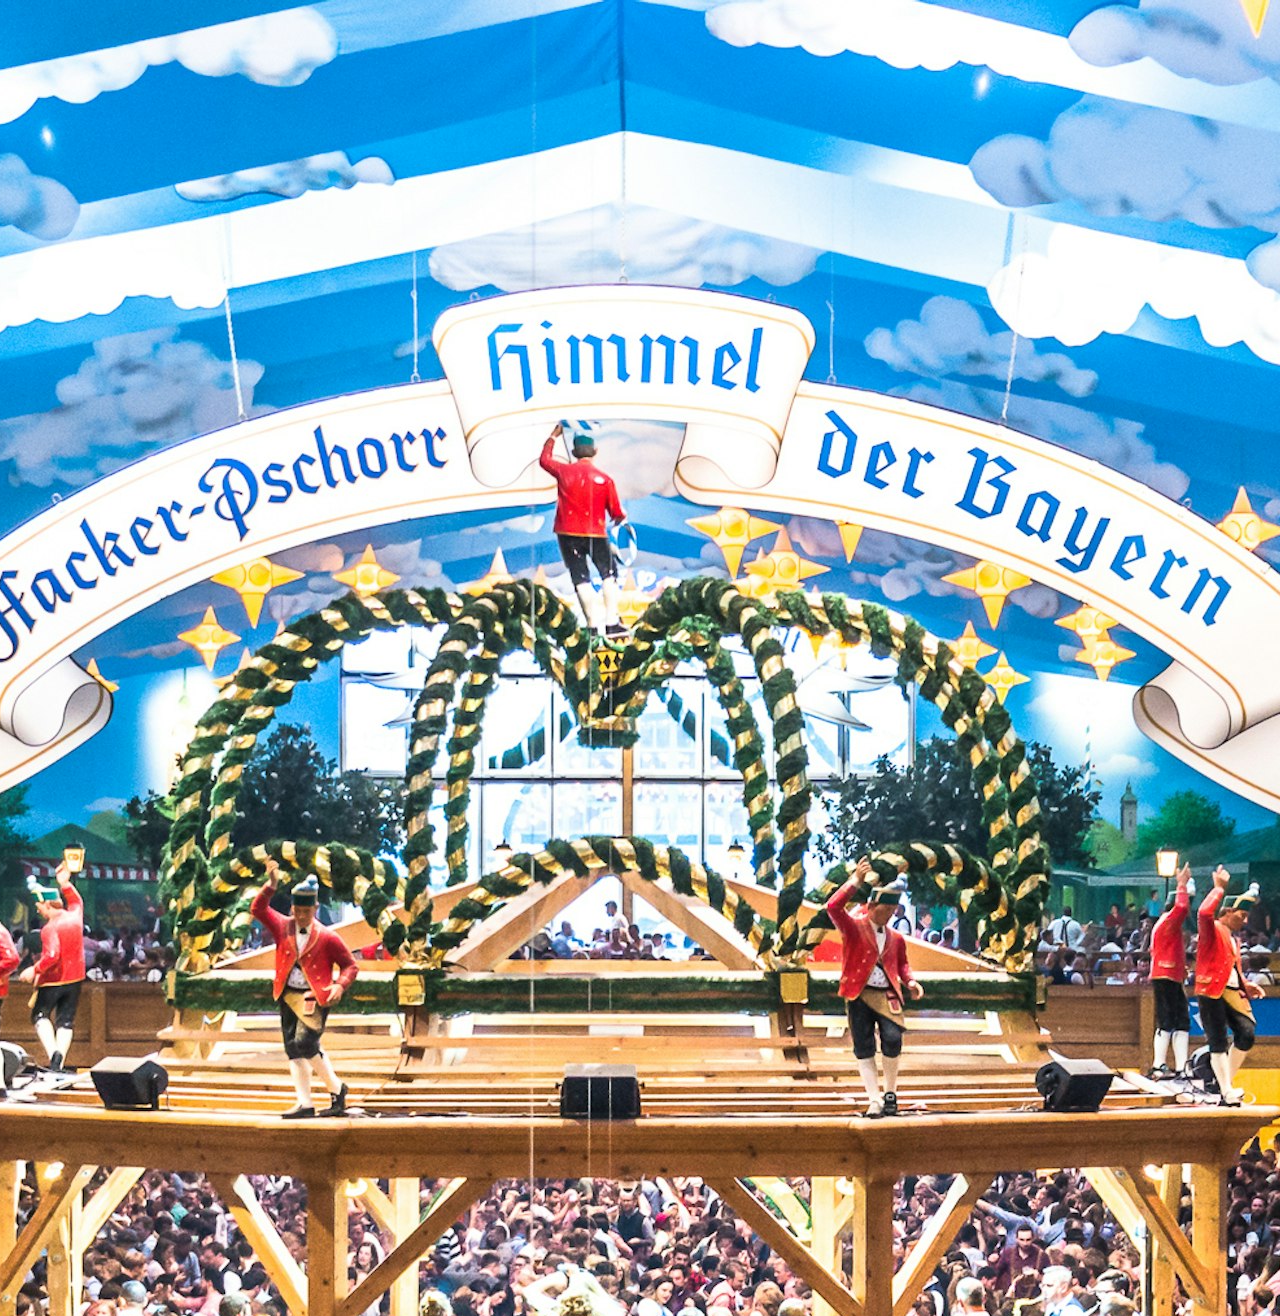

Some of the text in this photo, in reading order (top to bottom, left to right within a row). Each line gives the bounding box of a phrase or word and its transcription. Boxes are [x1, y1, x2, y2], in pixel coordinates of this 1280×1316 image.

[487, 320, 764, 402] Himmel
[817, 410, 935, 499] der
[955, 446, 1232, 627] Bayern
